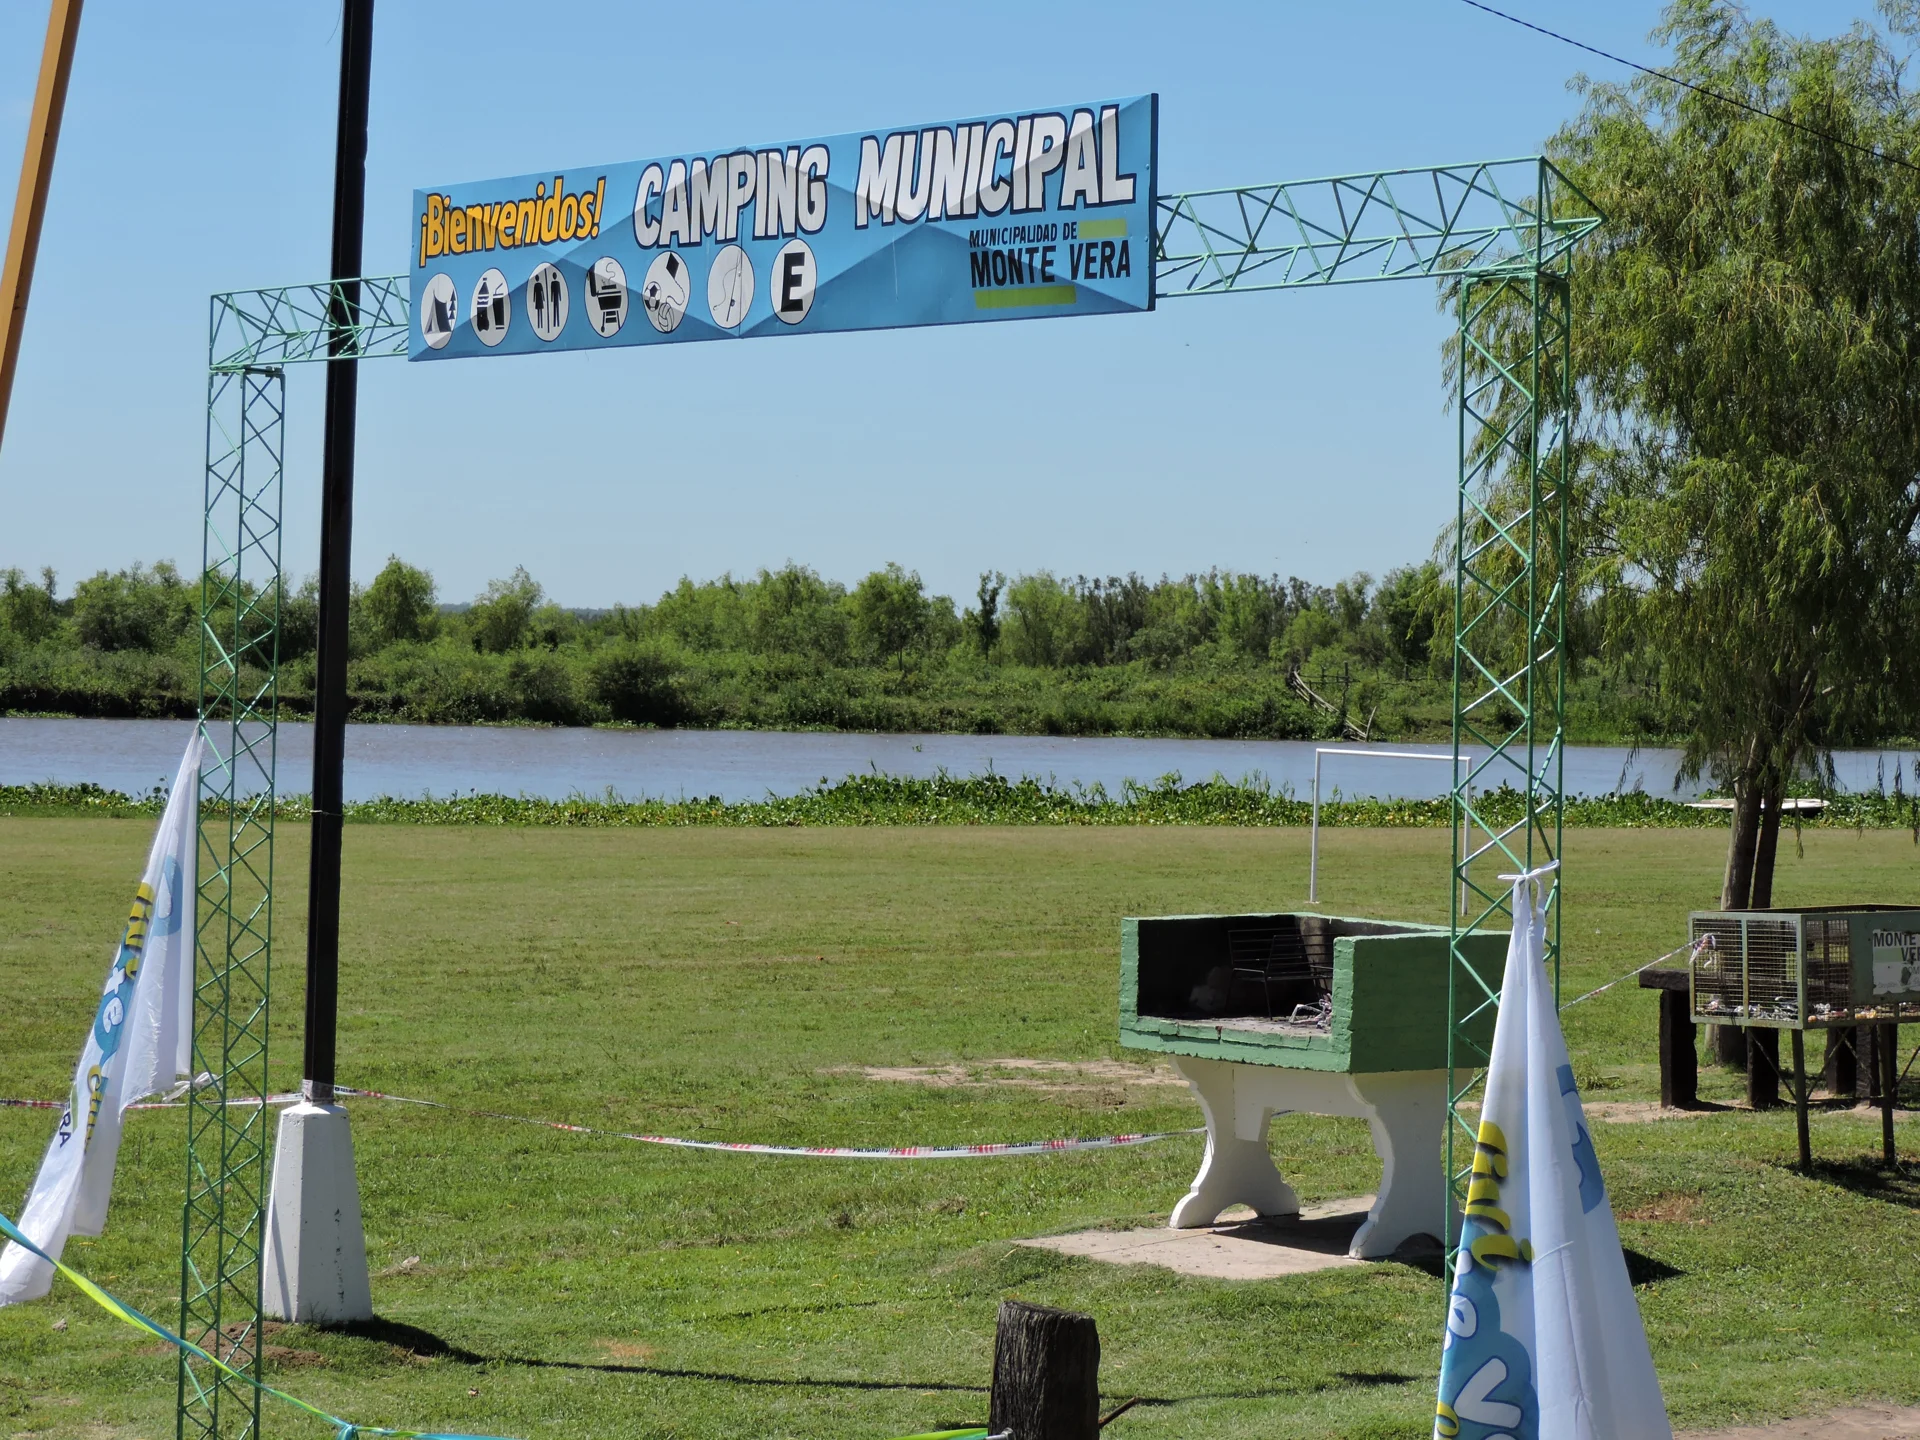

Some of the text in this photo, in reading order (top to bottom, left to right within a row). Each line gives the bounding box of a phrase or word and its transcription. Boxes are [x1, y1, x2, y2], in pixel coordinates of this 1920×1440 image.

[633, 104, 1137, 250] CAMPING MUNICIPAL
[419, 175, 607, 268] ¡Bienvenidos!
[969, 221, 1077, 248] MUNICIPALIDAD DE
[780, 252, 805, 312] E
[970, 239, 1132, 288] MONTE VERA
[1873, 932, 1917, 947] MONTE
